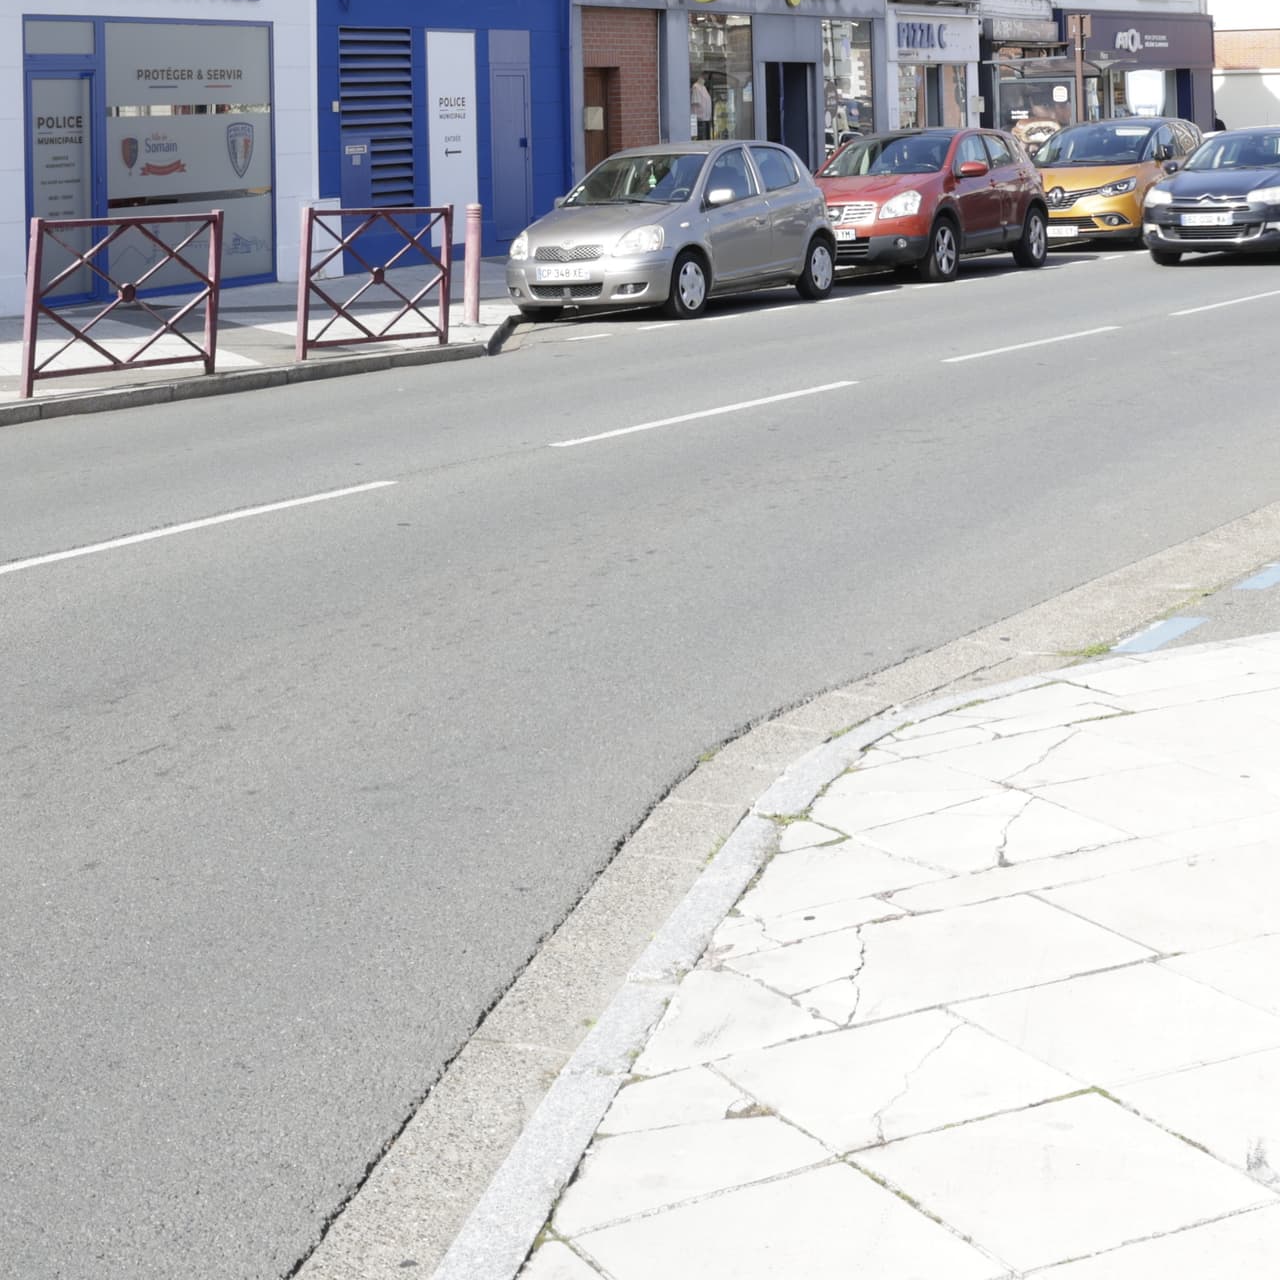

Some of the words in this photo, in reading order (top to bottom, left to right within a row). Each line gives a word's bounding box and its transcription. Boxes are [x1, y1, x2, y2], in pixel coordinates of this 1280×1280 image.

[897, 22, 935, 49] PIZZA
[1114, 28, 1144, 53] ATOL
[136, 66, 194, 81] PROTÉGER
[196, 69, 204, 80] &
[206, 68, 243, 80] SERVIR
[438, 96, 466, 107] POLICE
[37, 115, 83, 129] POLICE
[37, 135, 83, 145] MUNICIPALE
[144, 137, 178, 154] Somain
